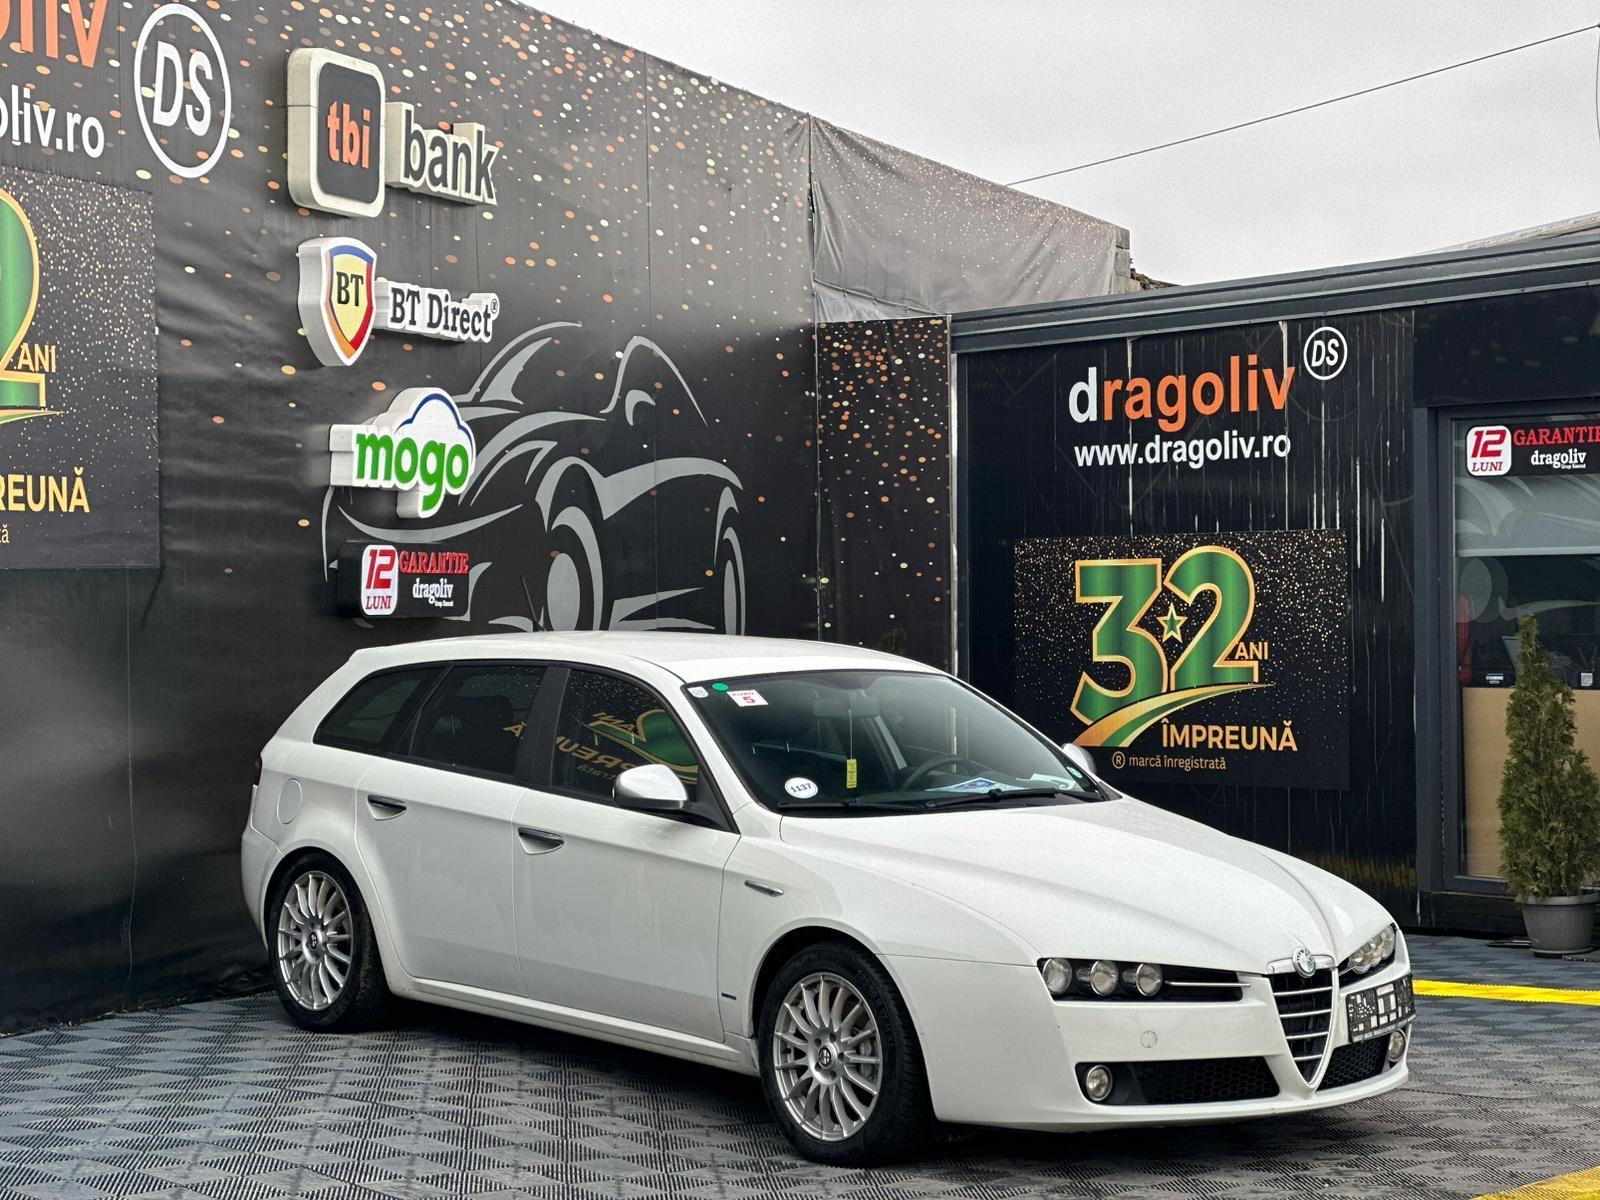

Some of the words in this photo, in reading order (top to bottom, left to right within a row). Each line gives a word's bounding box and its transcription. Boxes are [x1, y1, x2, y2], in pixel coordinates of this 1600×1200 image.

[153, 41, 213, 136] DS
[327, 101, 371, 169] tbi
[403, 108, 495, 200] bank
[336, 271, 364, 307] BT
[391, 286, 421, 326] BT
[17, 342, 57, 373] ANI
[1312, 338, 1340, 367] DS
[1068, 354, 1295, 432] dragoliv
[1074, 430, 1291, 469] www.dragoliv.ro
[1471, 429, 1507, 458] 12
[1530, 448, 1587, 469] dragoliv
[356, 433, 469, 511] mogo
[1472, 461, 1503, 472] LUNI
[365, 549, 395, 590] 12
[399, 550, 469, 574] GARANTIE
[365, 595, 392, 610] LUNI
[412, 577, 454, 605] dragoliv
[1070, 545, 1258, 726] 32
[1235, 641, 1268, 660] ANI
[742, 695, 757, 705] 5
[1161, 718, 1298, 751] ÎMPREUNĂ
[1129, 755, 1161, 768] marcă
[1163, 754, 1227, 772] înregistrată
